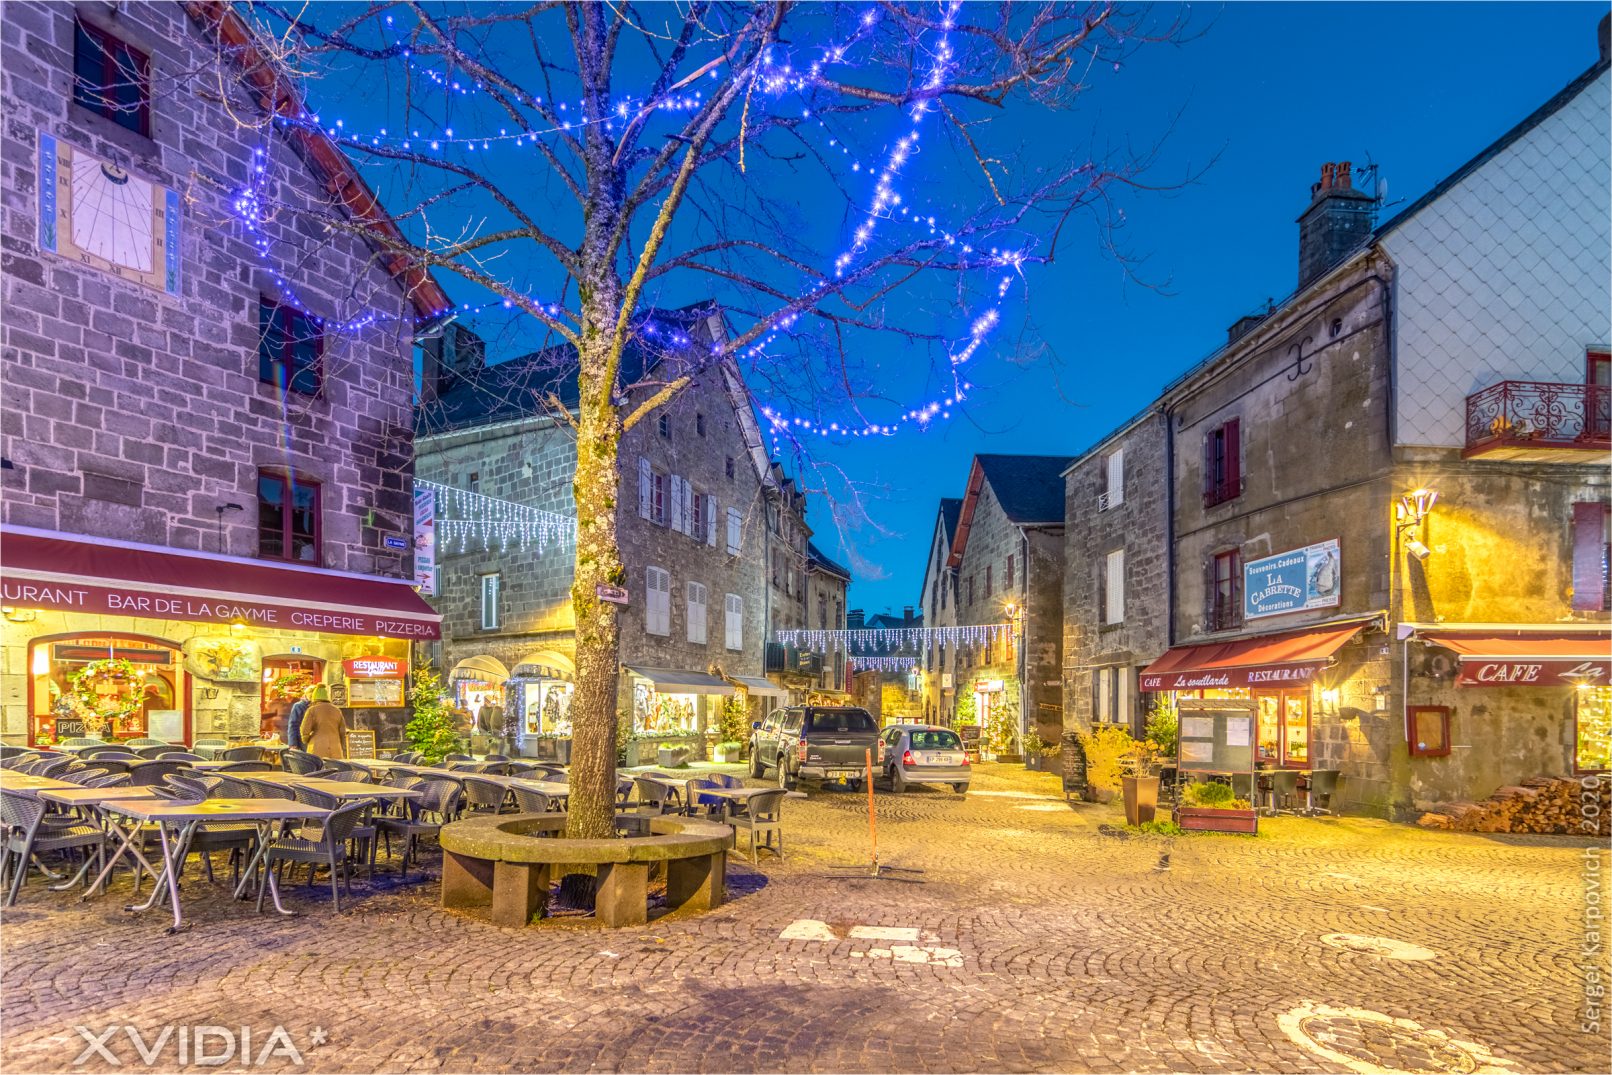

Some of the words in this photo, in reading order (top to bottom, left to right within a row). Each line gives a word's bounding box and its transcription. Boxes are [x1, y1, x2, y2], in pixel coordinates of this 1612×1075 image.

[1267, 573, 1282, 586] LA
[1251, 585, 1302, 605] CABRETTE
[108, 594, 150, 611] BAR
[155, 599, 183, 614] DE
[187, 602, 212, 616] LA
[215, 605, 278, 623] GAYME
[291, 612, 365, 631] CREPERIE
[375, 620, 435, 636] PIZZERIA
[353, 660, 398, 670] RESTAURANT
[1477, 664, 1543, 682] CAFE
[1557, 661, 1606, 677] La
[1144, 678, 1161, 687] CAFE
[1173, 674, 1186, 687] La
[1187, 673, 1229, 687] souillarde
[57, 721, 111, 735] PIZA
